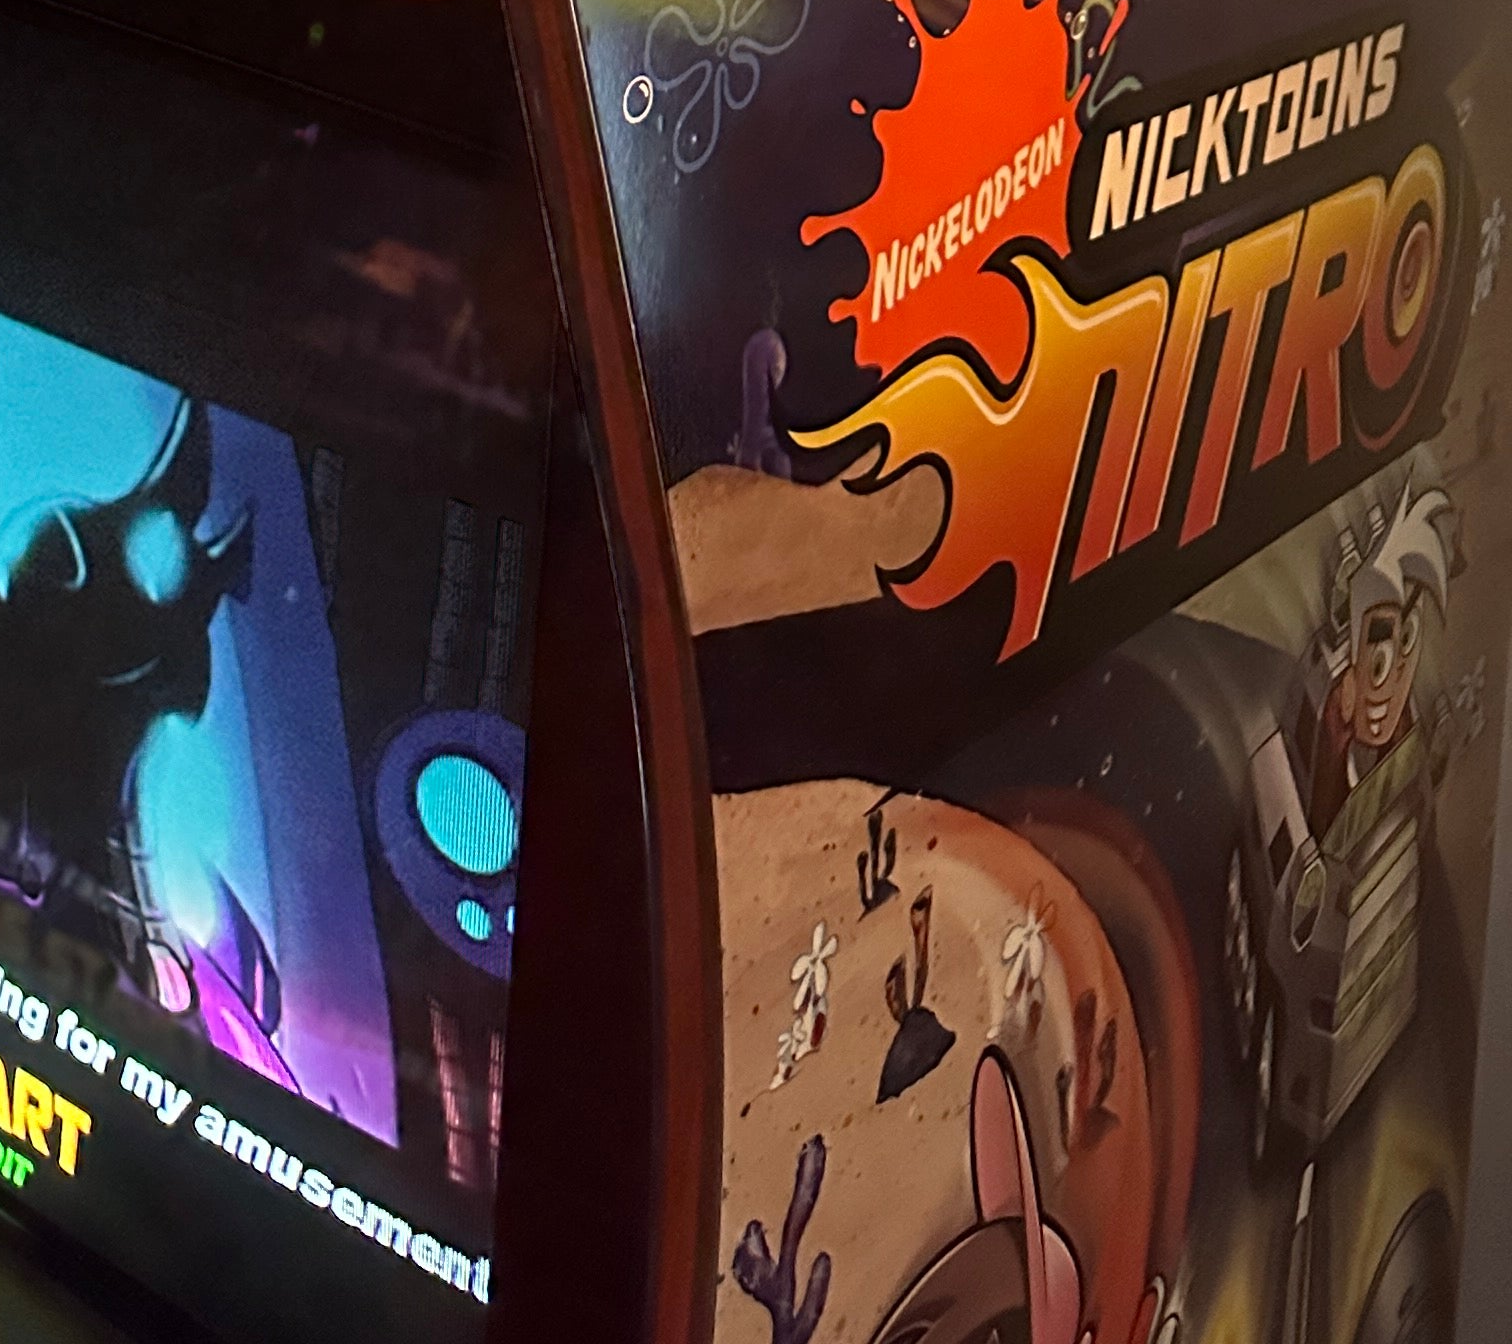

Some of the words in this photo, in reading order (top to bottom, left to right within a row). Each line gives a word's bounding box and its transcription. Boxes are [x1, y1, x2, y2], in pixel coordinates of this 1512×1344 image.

[870, 118, 1066, 323] NICKELODEON
[1088, 23, 1406, 240] NICKTOONS
[787, 142, 1448, 665] NITRO
[55, 1008, 118, 1075] for
[120, 1055, 193, 1127] my
